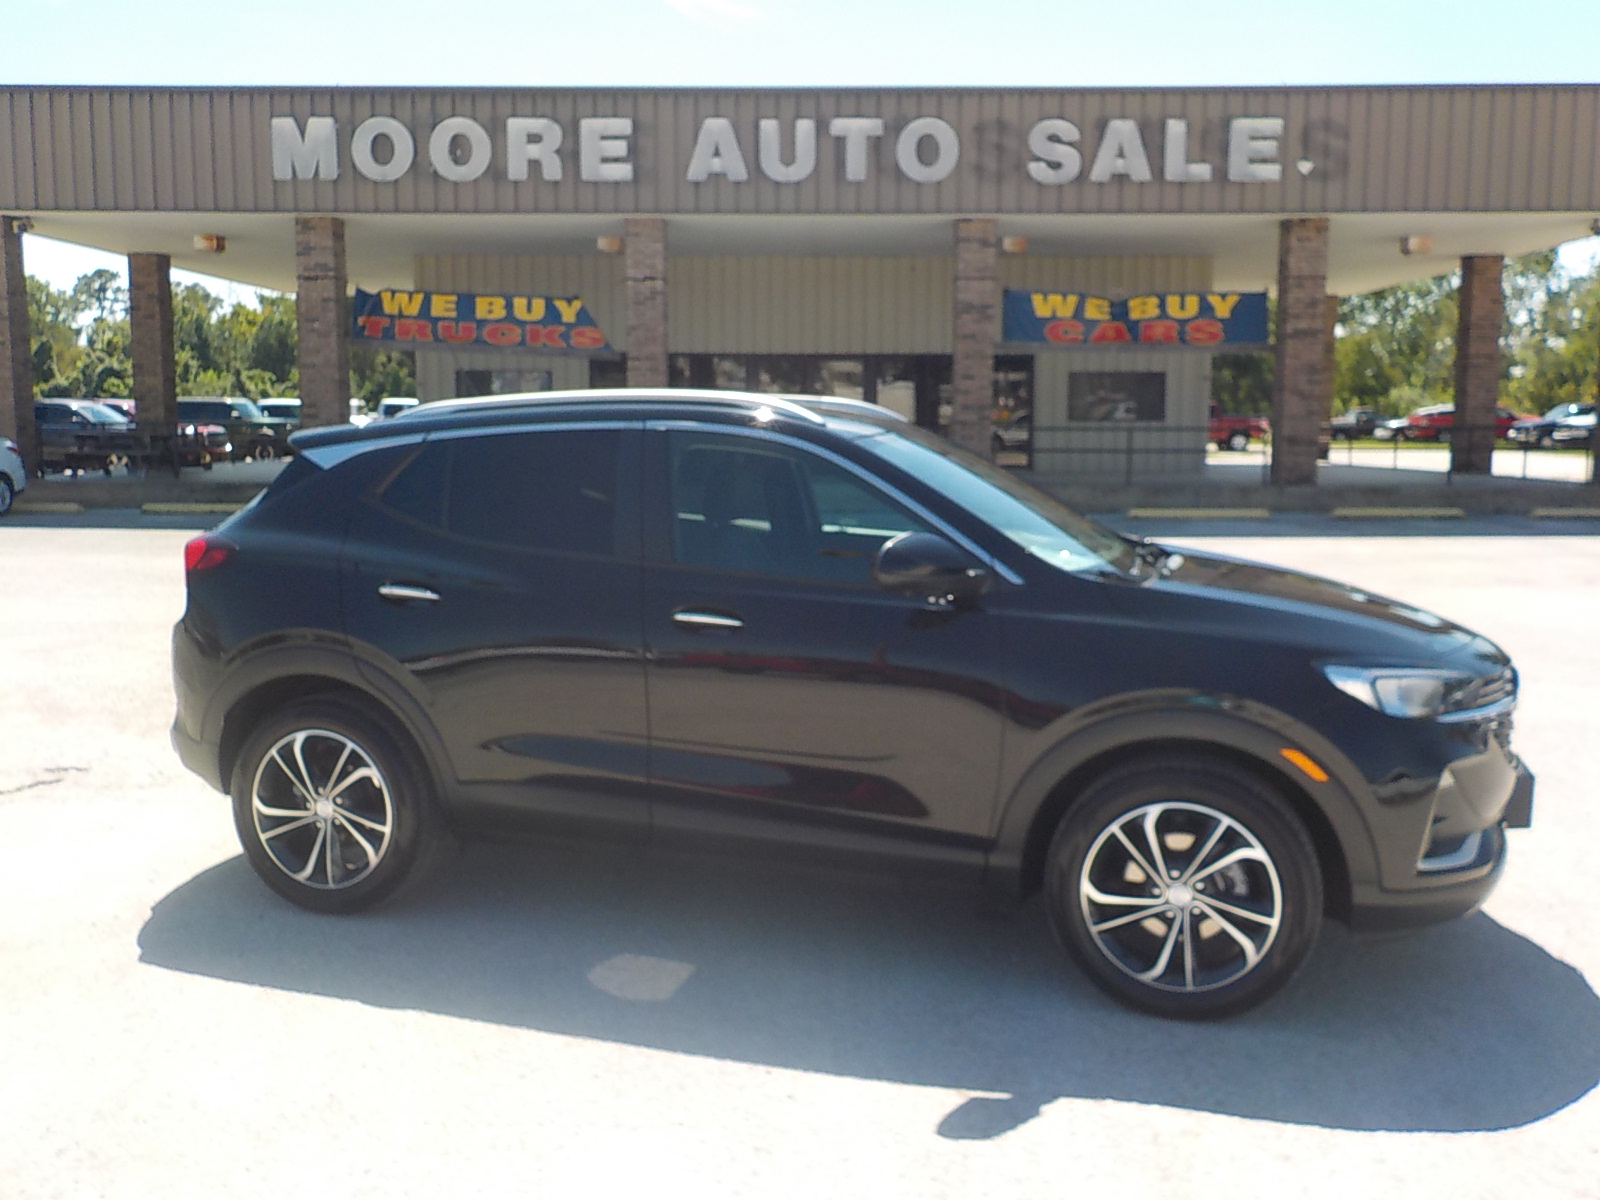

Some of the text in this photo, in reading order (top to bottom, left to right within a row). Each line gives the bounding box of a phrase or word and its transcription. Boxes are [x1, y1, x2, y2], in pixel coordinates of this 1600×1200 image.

[271, 115, 634, 183] MOORE
[686, 116, 960, 183] AUTO
[380, 291, 582, 324] WE BUY
[1030, 292, 1240, 320] WE BUY
[357, 316, 605, 349] TRUCKS
[1044, 319, 1225, 345] CARS
